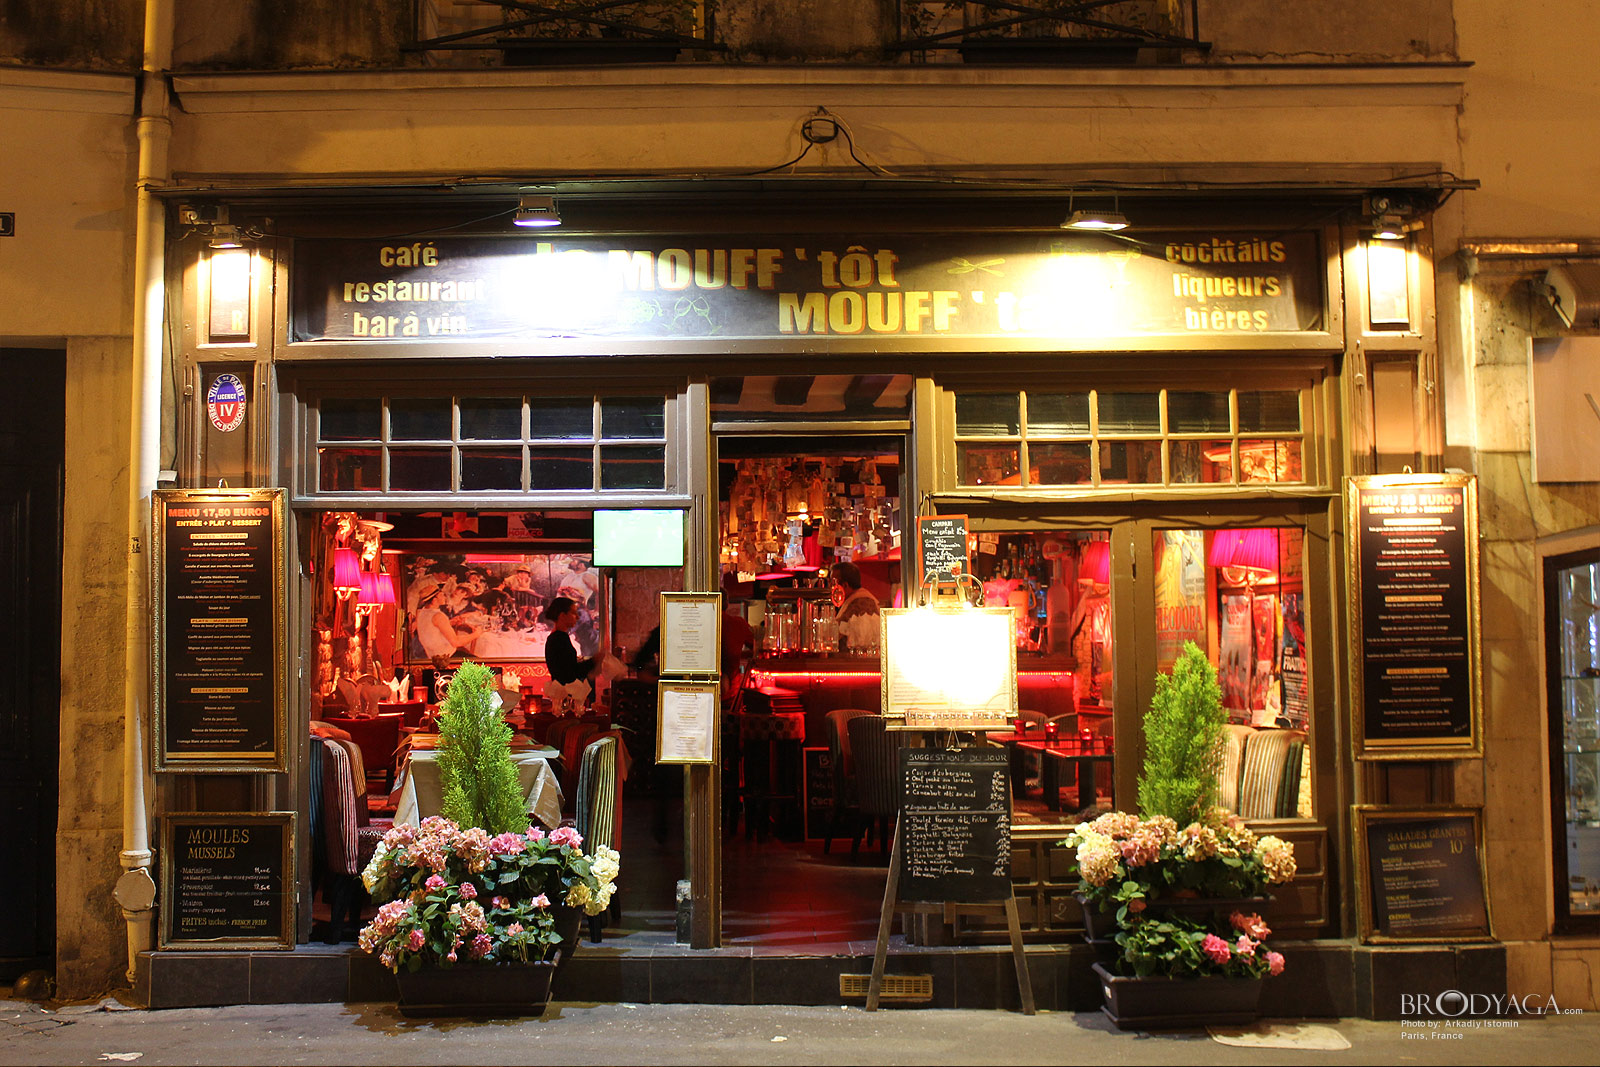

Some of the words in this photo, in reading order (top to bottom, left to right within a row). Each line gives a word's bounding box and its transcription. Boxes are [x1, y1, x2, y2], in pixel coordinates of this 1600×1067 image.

[380, 242, 438, 267] café
[1165, 238, 1287, 263] cocktails
[344, 279, 485, 303] restaurant
[1172, 273, 1281, 302] liqueurs
[778, 291, 962, 334] MOUFF
[1185, 303, 1269, 330] bières
[353, 312, 400, 336] bar
[403, 311, 420, 336] à
[427, 312, 467, 335] vin
[220, 404, 235, 417] IV
[1361, 494, 1398, 507] MENU
[1419, 492, 1463, 506] EUROS
[168, 508, 200, 518] MENU
[202, 508, 231, 518] 17,50
[233, 507, 270, 517] EUROS
[176, 519, 203, 527] ENTRÉE
[909, 754, 965, 762] SUGGESTIONS
[984, 754, 1008, 762] JOUR
[187, 828, 250, 845] MOULES
[188, 846, 236, 860] MUSSELS
[1450, 839, 1463, 855] 10
[181, 917, 207, 926] FRITES
